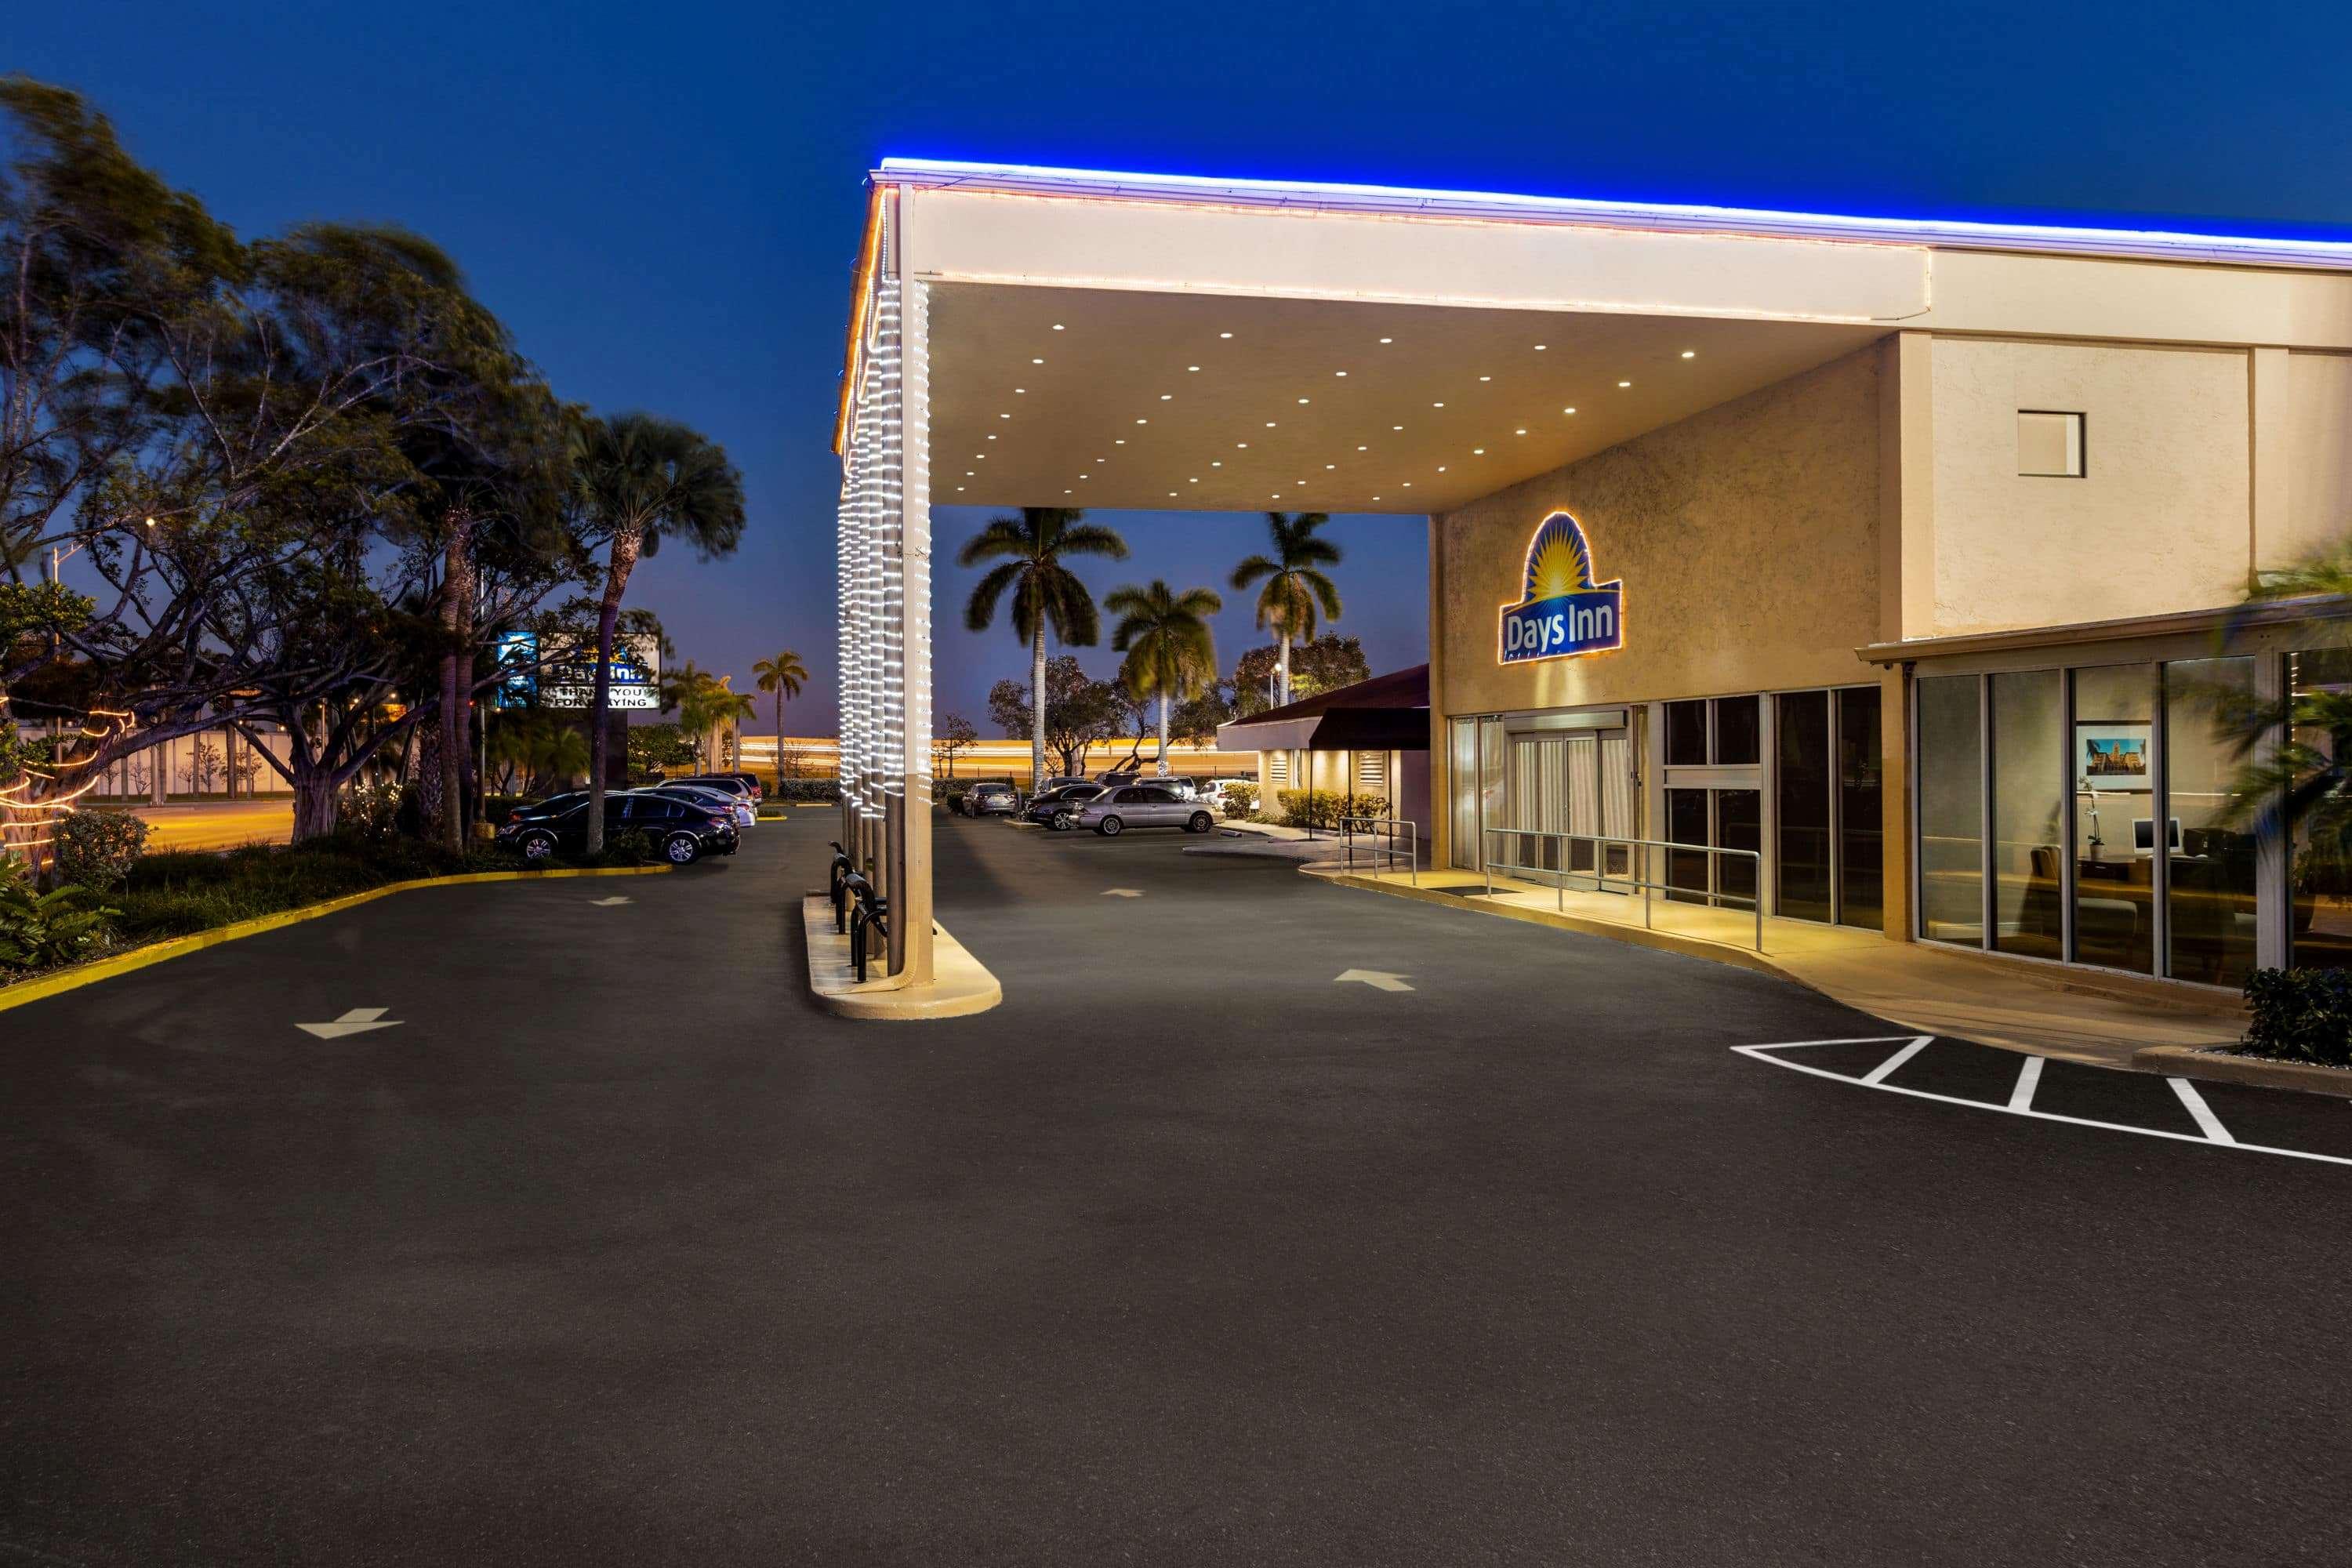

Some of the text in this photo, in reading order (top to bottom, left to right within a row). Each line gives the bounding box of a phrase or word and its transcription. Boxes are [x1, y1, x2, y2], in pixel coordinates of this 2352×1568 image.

[1508, 604, 1613, 652] Days Inn
[560, 688, 641, 696] THAN YOU
